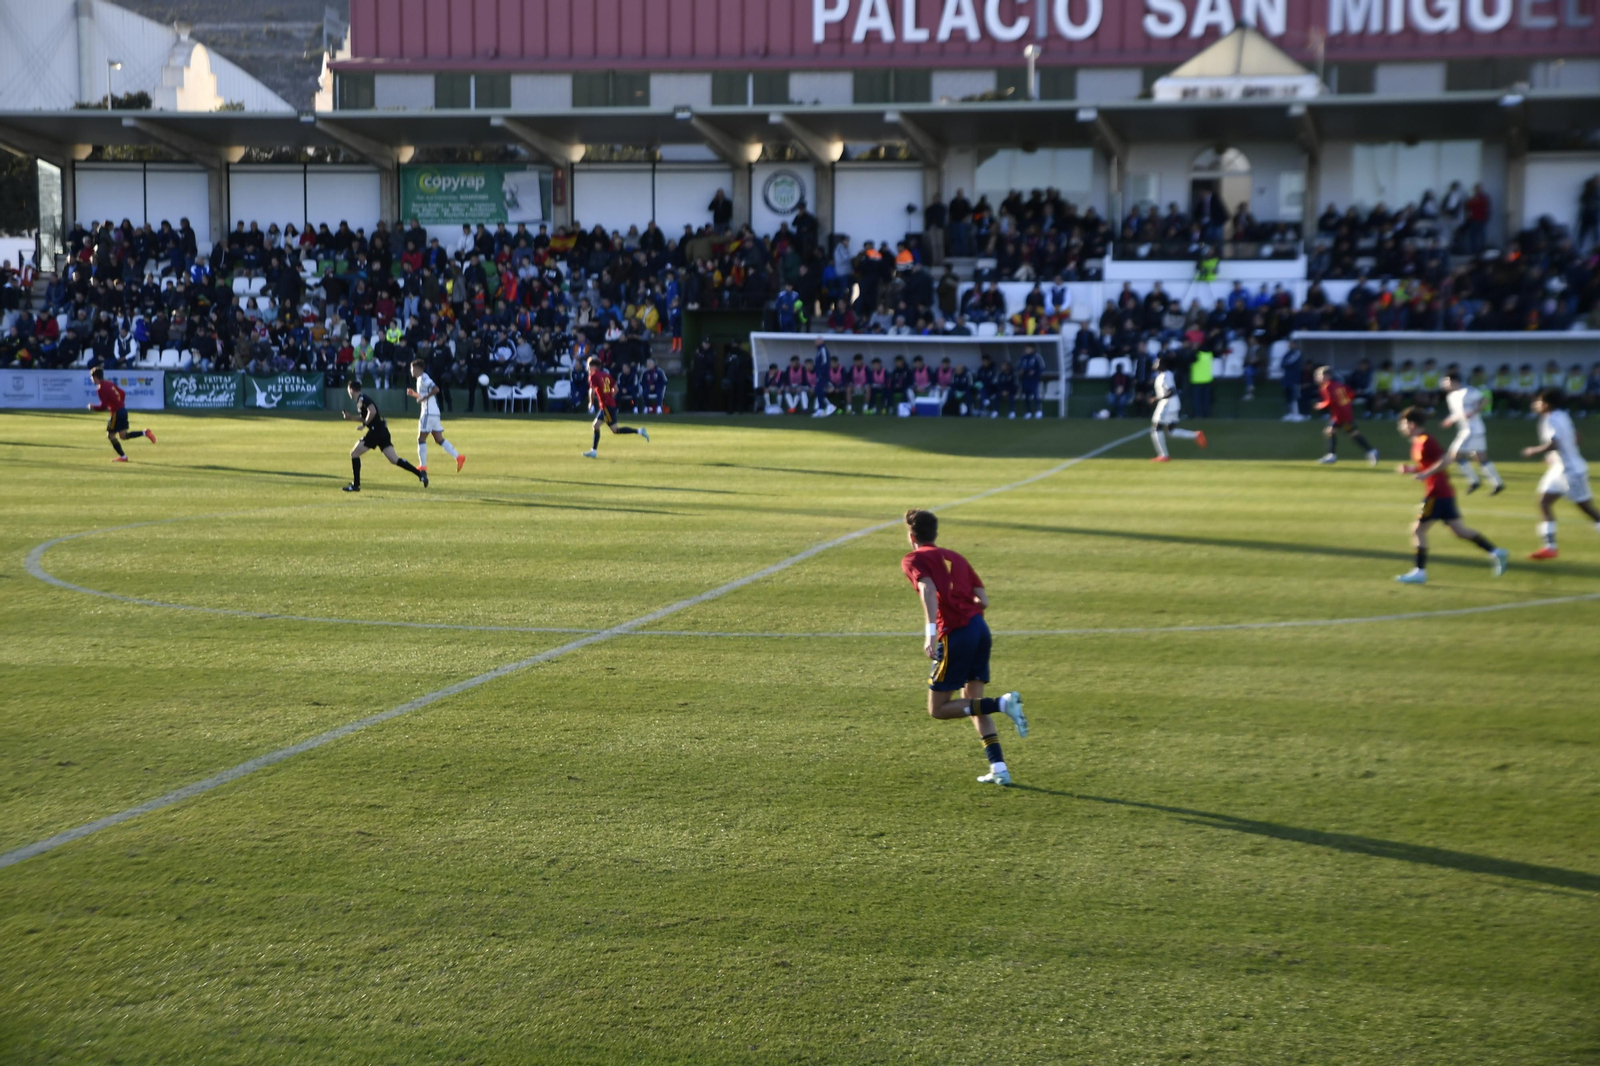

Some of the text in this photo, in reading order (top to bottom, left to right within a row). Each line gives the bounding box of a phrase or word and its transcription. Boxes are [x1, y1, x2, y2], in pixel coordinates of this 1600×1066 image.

[811, 0, 1104, 43] PALACIO
[1143, 0, 1287, 39] SAN
[424, 174, 485, 191] copyrap
[278, 376, 307, 384] HOTEL
[267, 384, 317, 392] PEZ ESPADA
